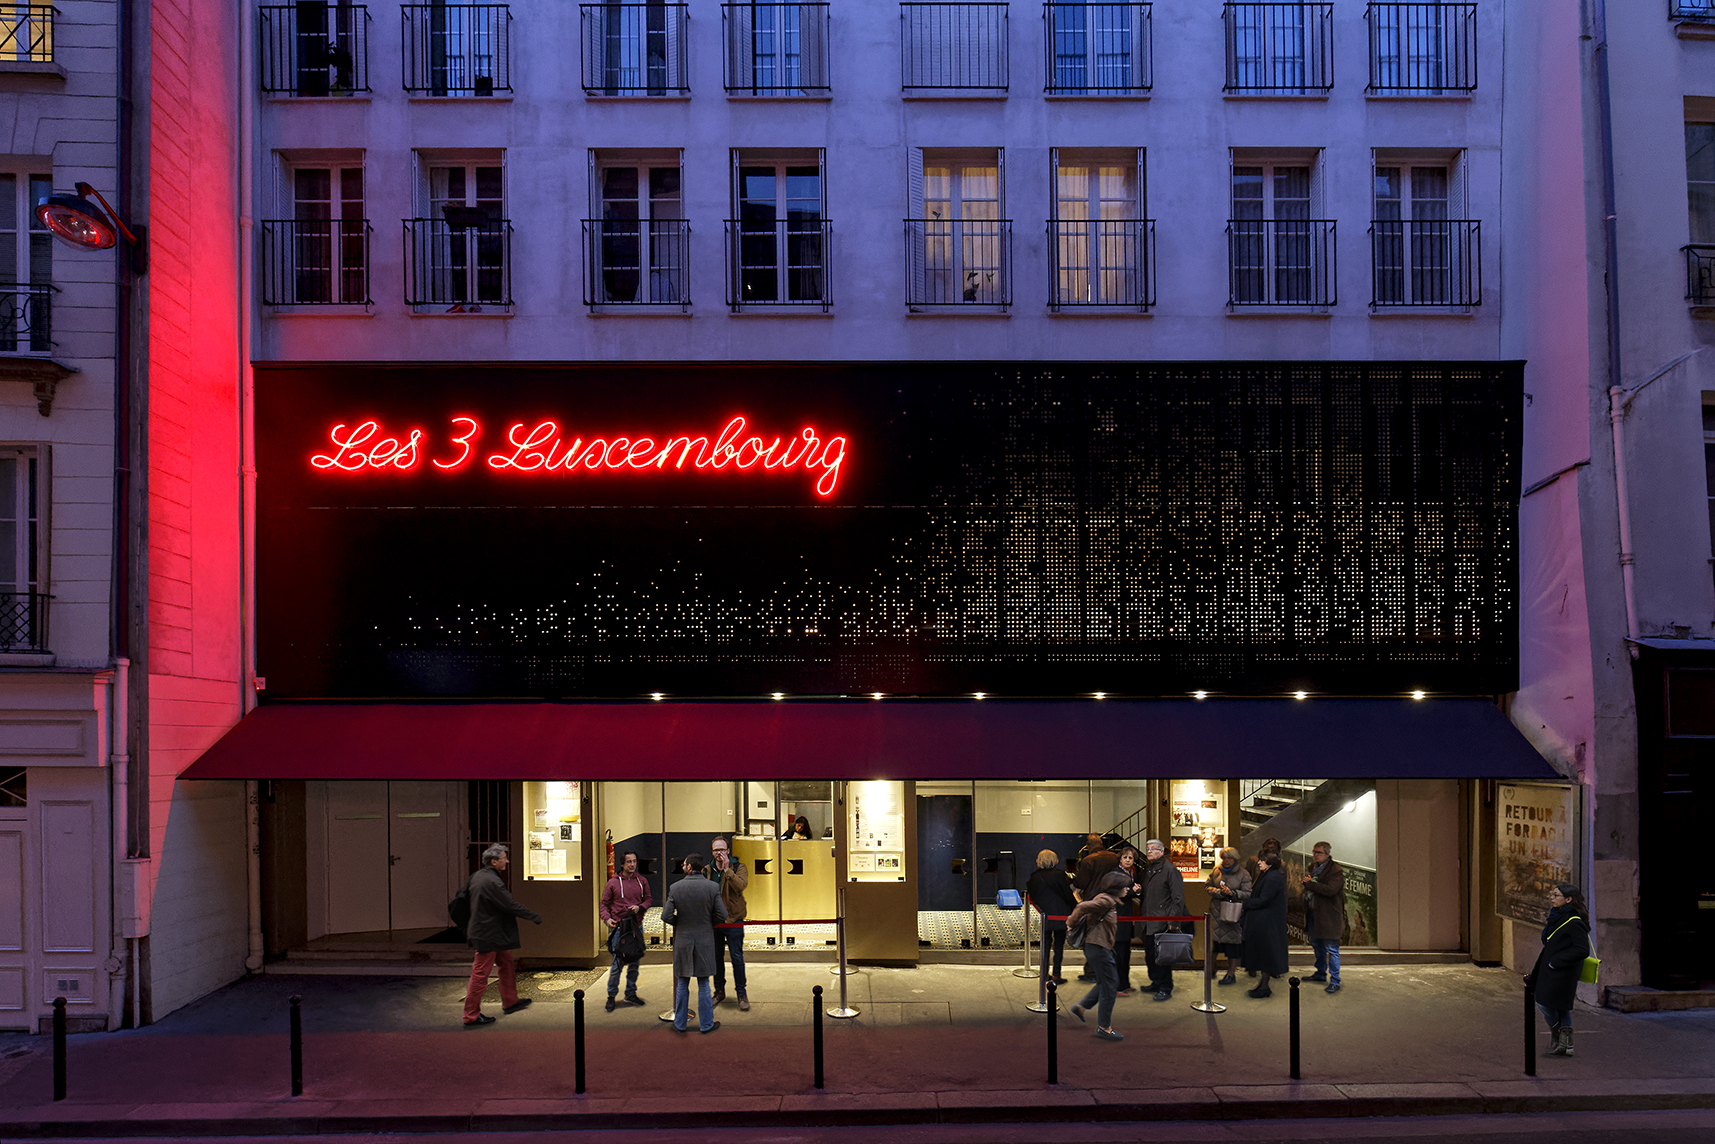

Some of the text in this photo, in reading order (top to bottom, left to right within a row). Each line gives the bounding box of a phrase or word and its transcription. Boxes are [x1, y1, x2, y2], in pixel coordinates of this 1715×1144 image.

[310, 416, 847, 496] Les 3 Luxembourg
[1505, 804, 1552, 823] RETOUR
[1509, 840, 1526, 856] UN
[1532, 843, 1562, 861] FIL
[1350, 879, 1372, 896] FEMME
